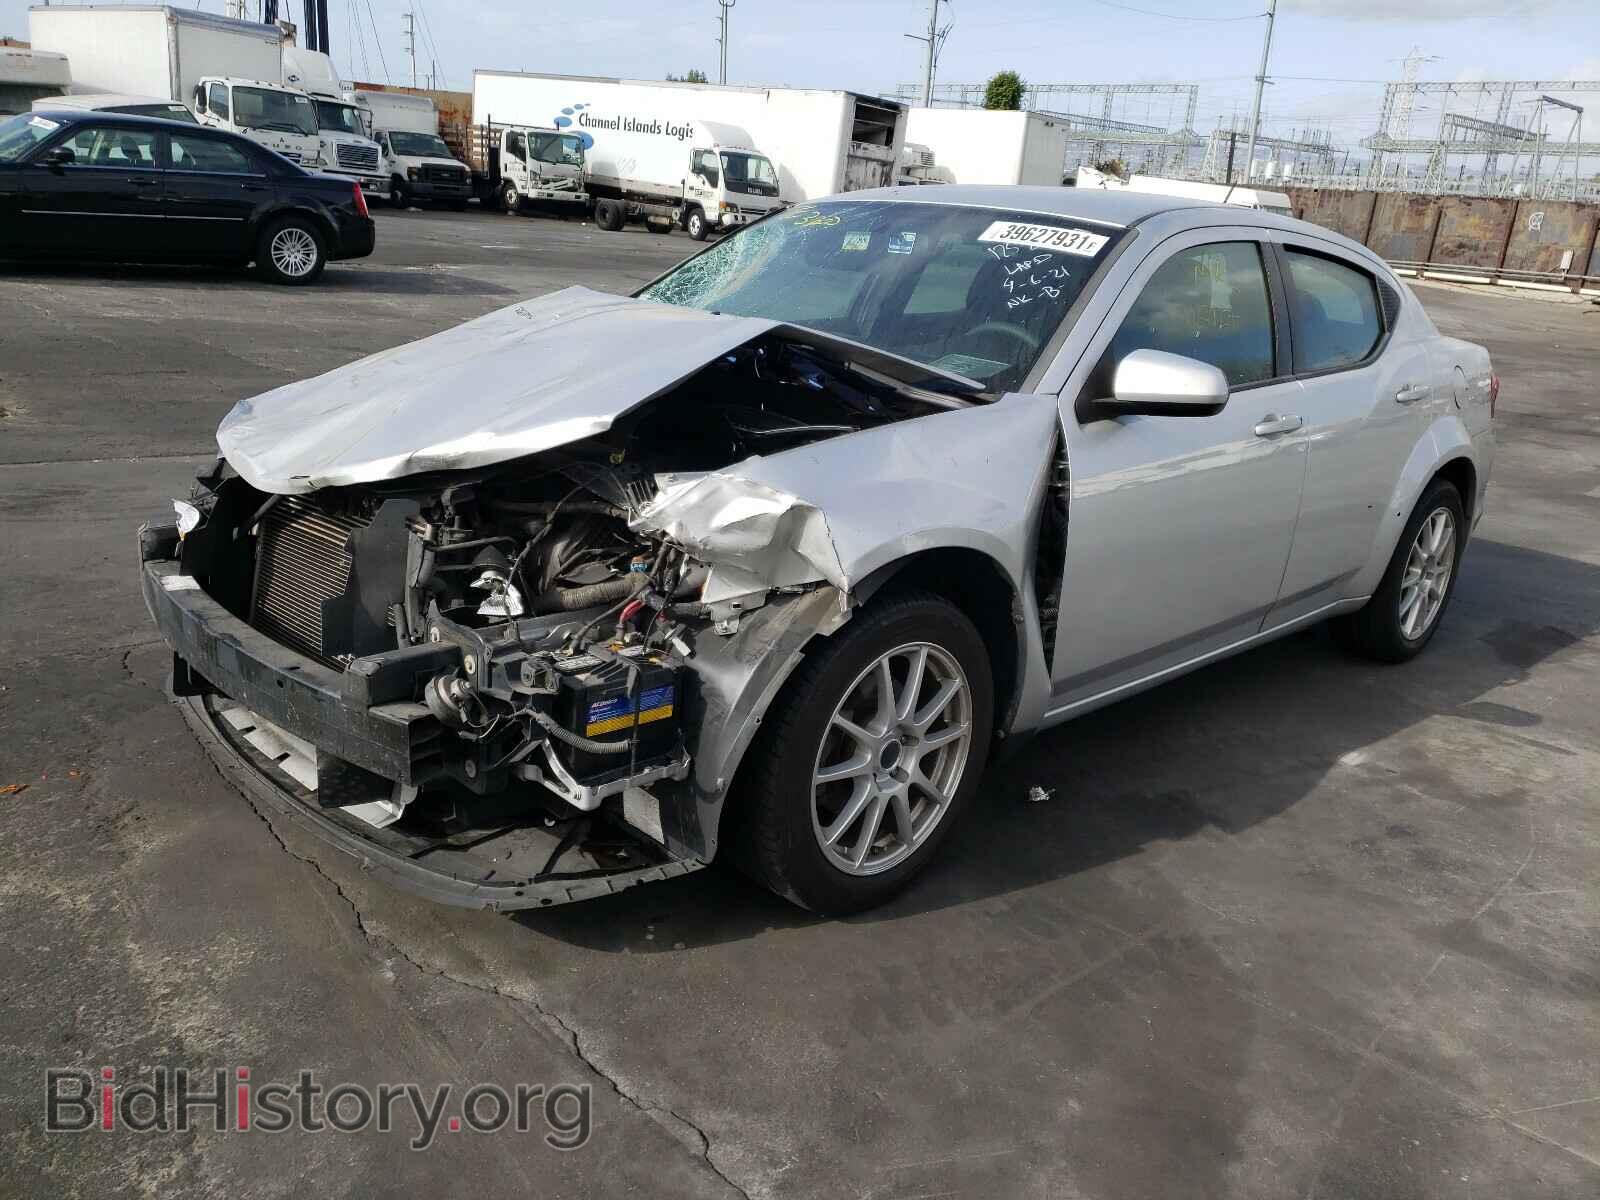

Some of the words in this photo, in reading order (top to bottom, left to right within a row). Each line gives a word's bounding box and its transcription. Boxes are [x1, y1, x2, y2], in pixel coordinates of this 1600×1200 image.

[579, 112, 620, 131] Channel
[623, 117, 662, 135] Islands
[1000, 224, 1089, 249] 39627931
